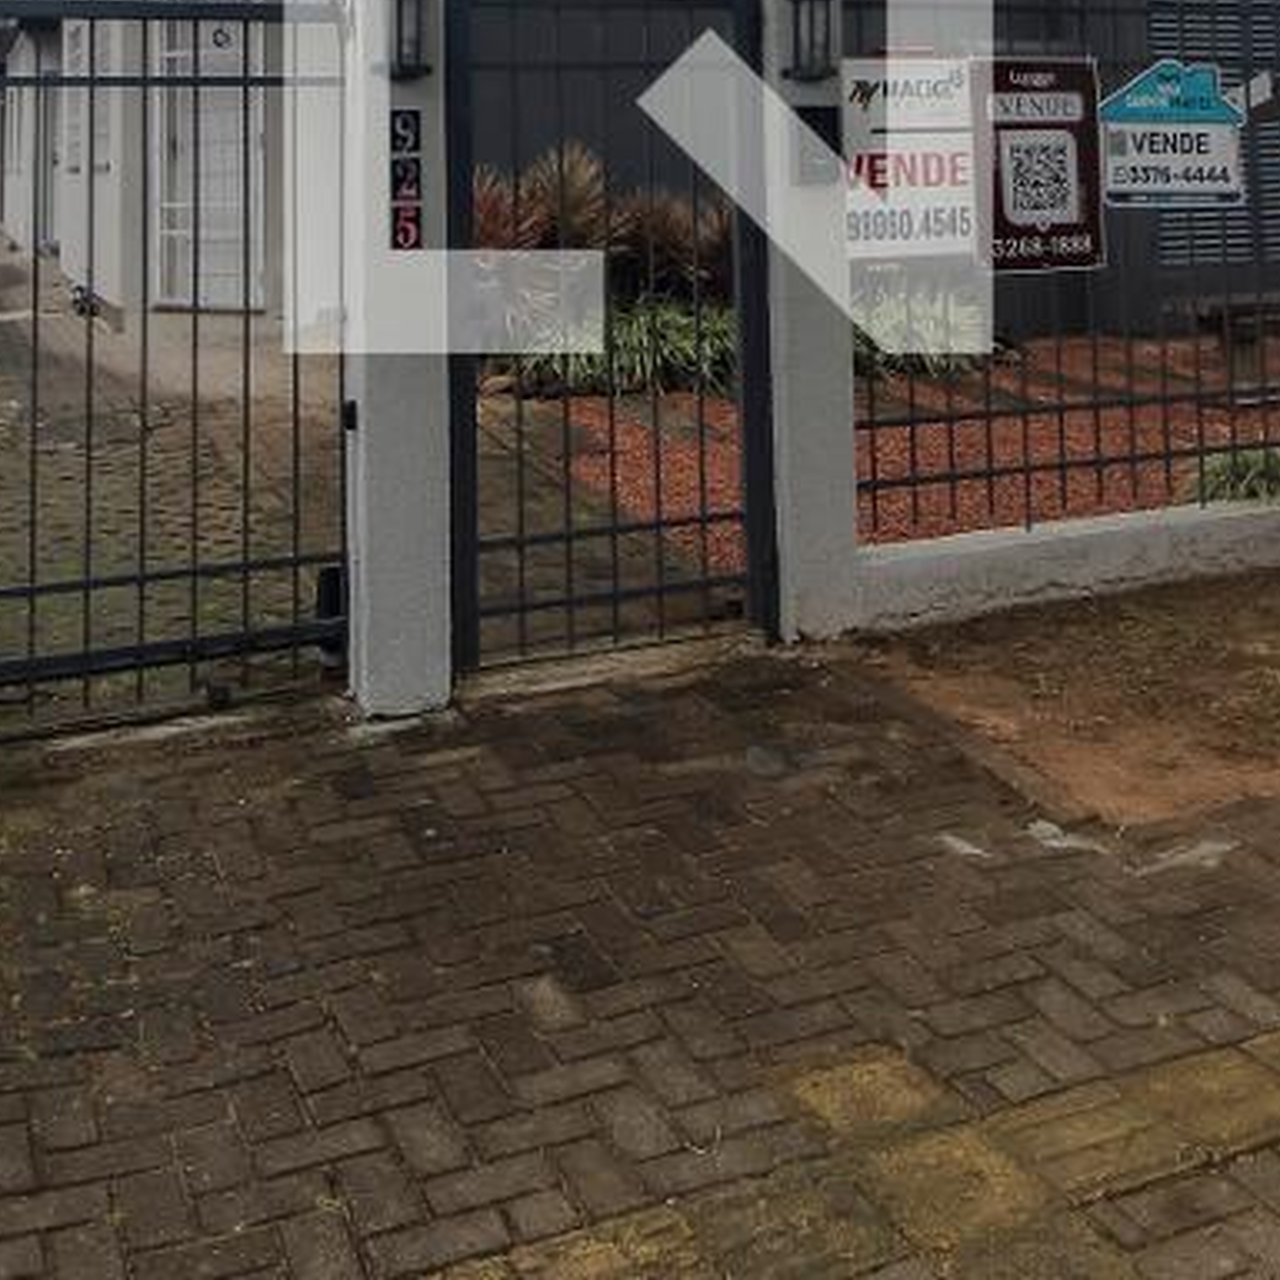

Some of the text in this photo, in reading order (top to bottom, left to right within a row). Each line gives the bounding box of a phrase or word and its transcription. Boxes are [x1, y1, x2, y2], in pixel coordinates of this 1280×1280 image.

[998, 100, 1077, 119] VENDE
[1131, 132, 1211, 155] VENDE
[394, 112, 418, 249] 925
[845, 152, 970, 189] VENDE
